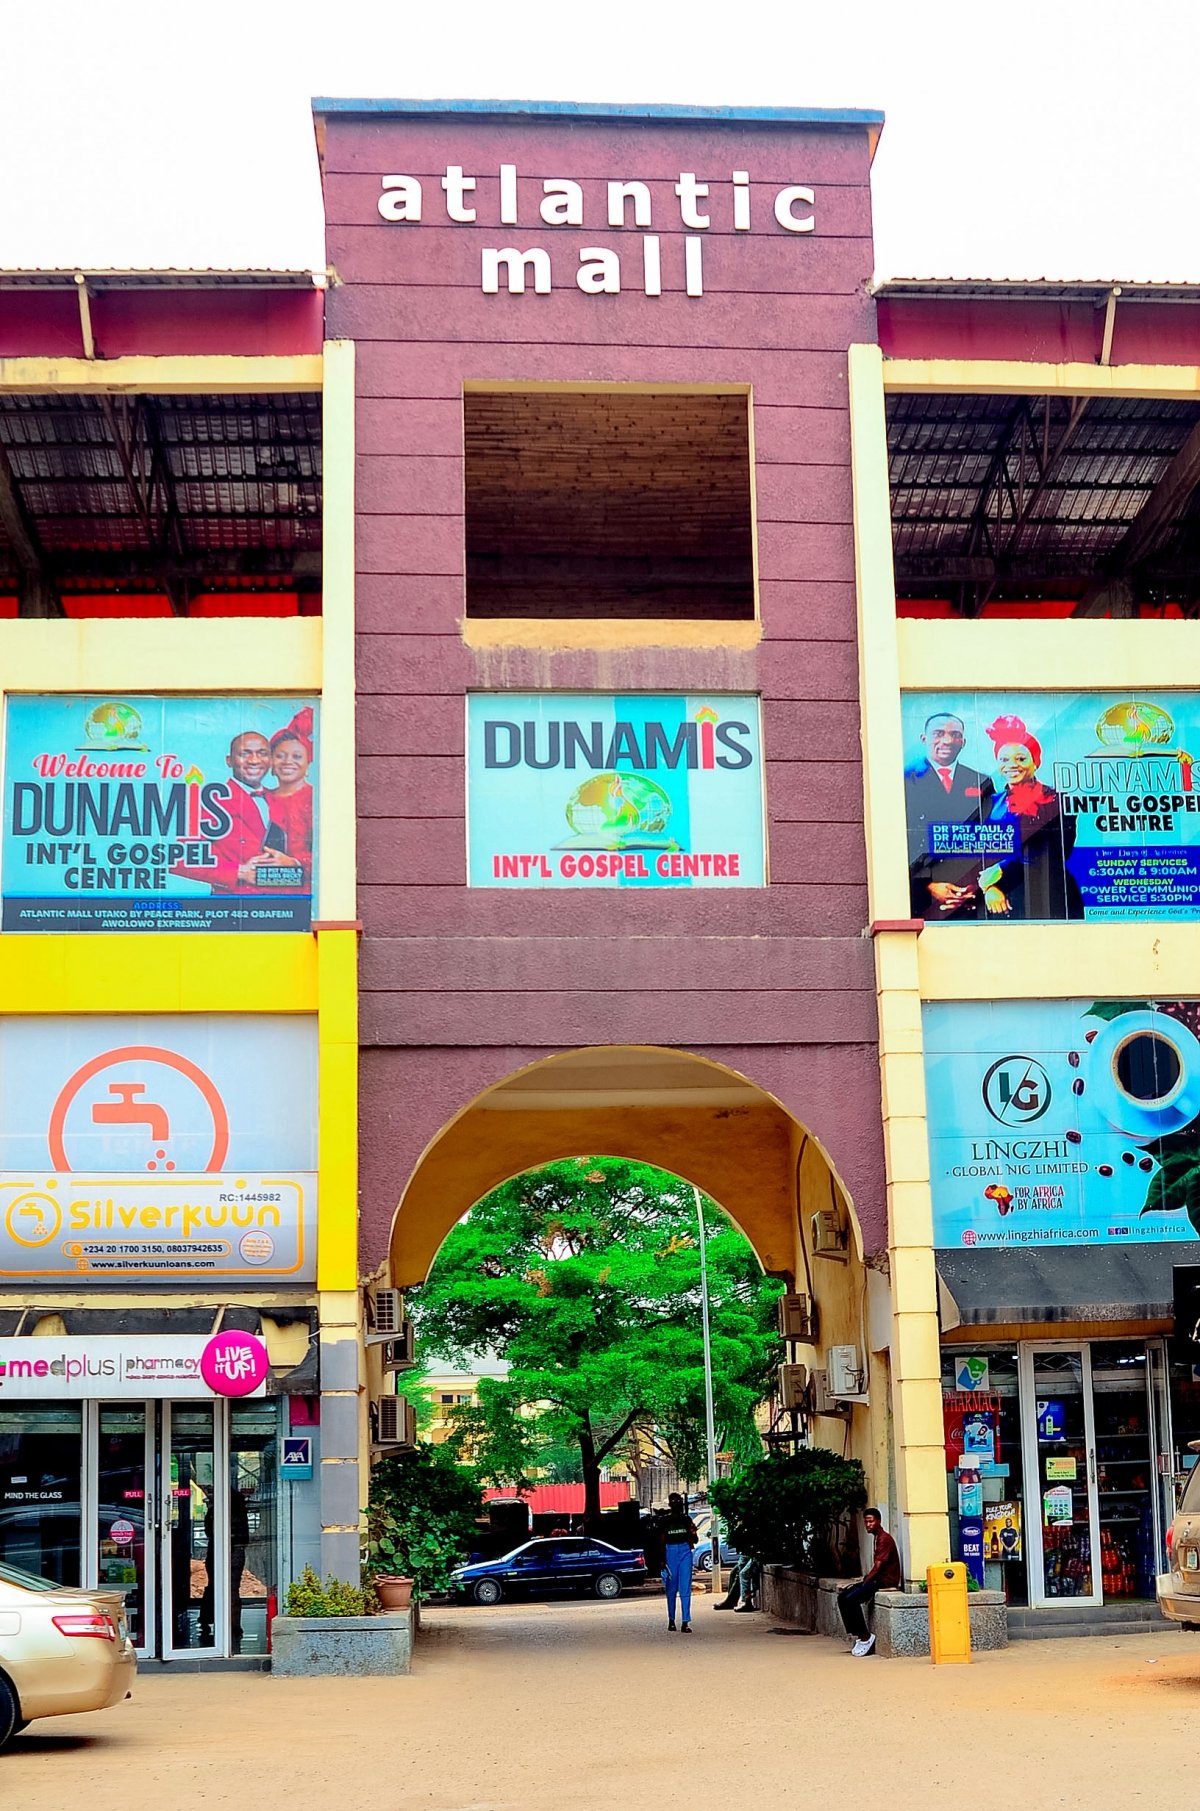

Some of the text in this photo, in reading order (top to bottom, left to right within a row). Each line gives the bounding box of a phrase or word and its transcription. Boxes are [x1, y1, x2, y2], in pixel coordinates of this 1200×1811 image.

[377, 164, 816, 232] atlantic
[481, 235, 703, 296] mall
[484, 716, 753, 770] DUNAMIS
[33, 753, 184, 779] Welcome To
[12, 778, 231, 838] DUNAMIS
[1065, 795, 1119, 813] INT'L
[933, 825, 1014, 833] DR PST PAUL &
[1095, 815, 1173, 832] CENTRE
[933, 833, 1014, 841] DR MRS BECKY
[934, 841, 1014, 850] PAUL-ENENCHE
[26, 843, 216, 866] INT'L GOSPEL
[493, 854, 740, 878] INT'L GOSPEL CENTRE
[1089, 868, 1135, 876] 6:30AM
[1150, 867, 1197, 875] 9:00AM
[64, 867, 167, 889] CENTRE
[1081, 885, 1200, 894] POWER COMMUNIO
[19, 910, 65, 918] ATLANTIC
[66, 910, 92, 918] MALL
[94, 910, 128, 918] UTAKO
[129, 910, 142, 918] BY
[144, 910, 173, 918] PEACE
[175, 910, 203, 919] PARK,
[205, 910, 229, 918] PLOT
[250, 910, 293, 918] OBAFEMI
[1089, 908, 1109, 916] Come
[101, 919, 212, 928] AWOLOWO EXPRESWAY
[972, 1140, 1069, 1160] LINGZHI
[952, 1166, 1003, 1176] GLOBAL
[1036, 1162, 1088, 1173] LIMITED
[219, 1193, 281, 1202] RC:1445982
[1014, 1186, 1064, 1199] FOR AFRICA
[1017, 1198, 1063, 1210] BY AFRICA
[69, 1199, 281, 1237] Silverkuun
[977, 1226, 1186, 1241] www.lingzhiafrica.com lingzhiafrica
[83, 1245, 104, 1253] +234
[106, 1245, 117, 1253] 20
[119, 1245, 139, 1253] 1700
[141, 1244, 165, 1254] 3150,
[91, 1259, 215, 1268] www.silverkuunloans.com
[9, 1354, 201, 1382] medplus pharmacy
[944, 1391, 1002, 1412] PHARMACY
[284, 1451, 305, 1462] AXA
[4, 1491, 62, 1499] MIND THE GLASS
[963, 1543, 980, 1552] BEAT
